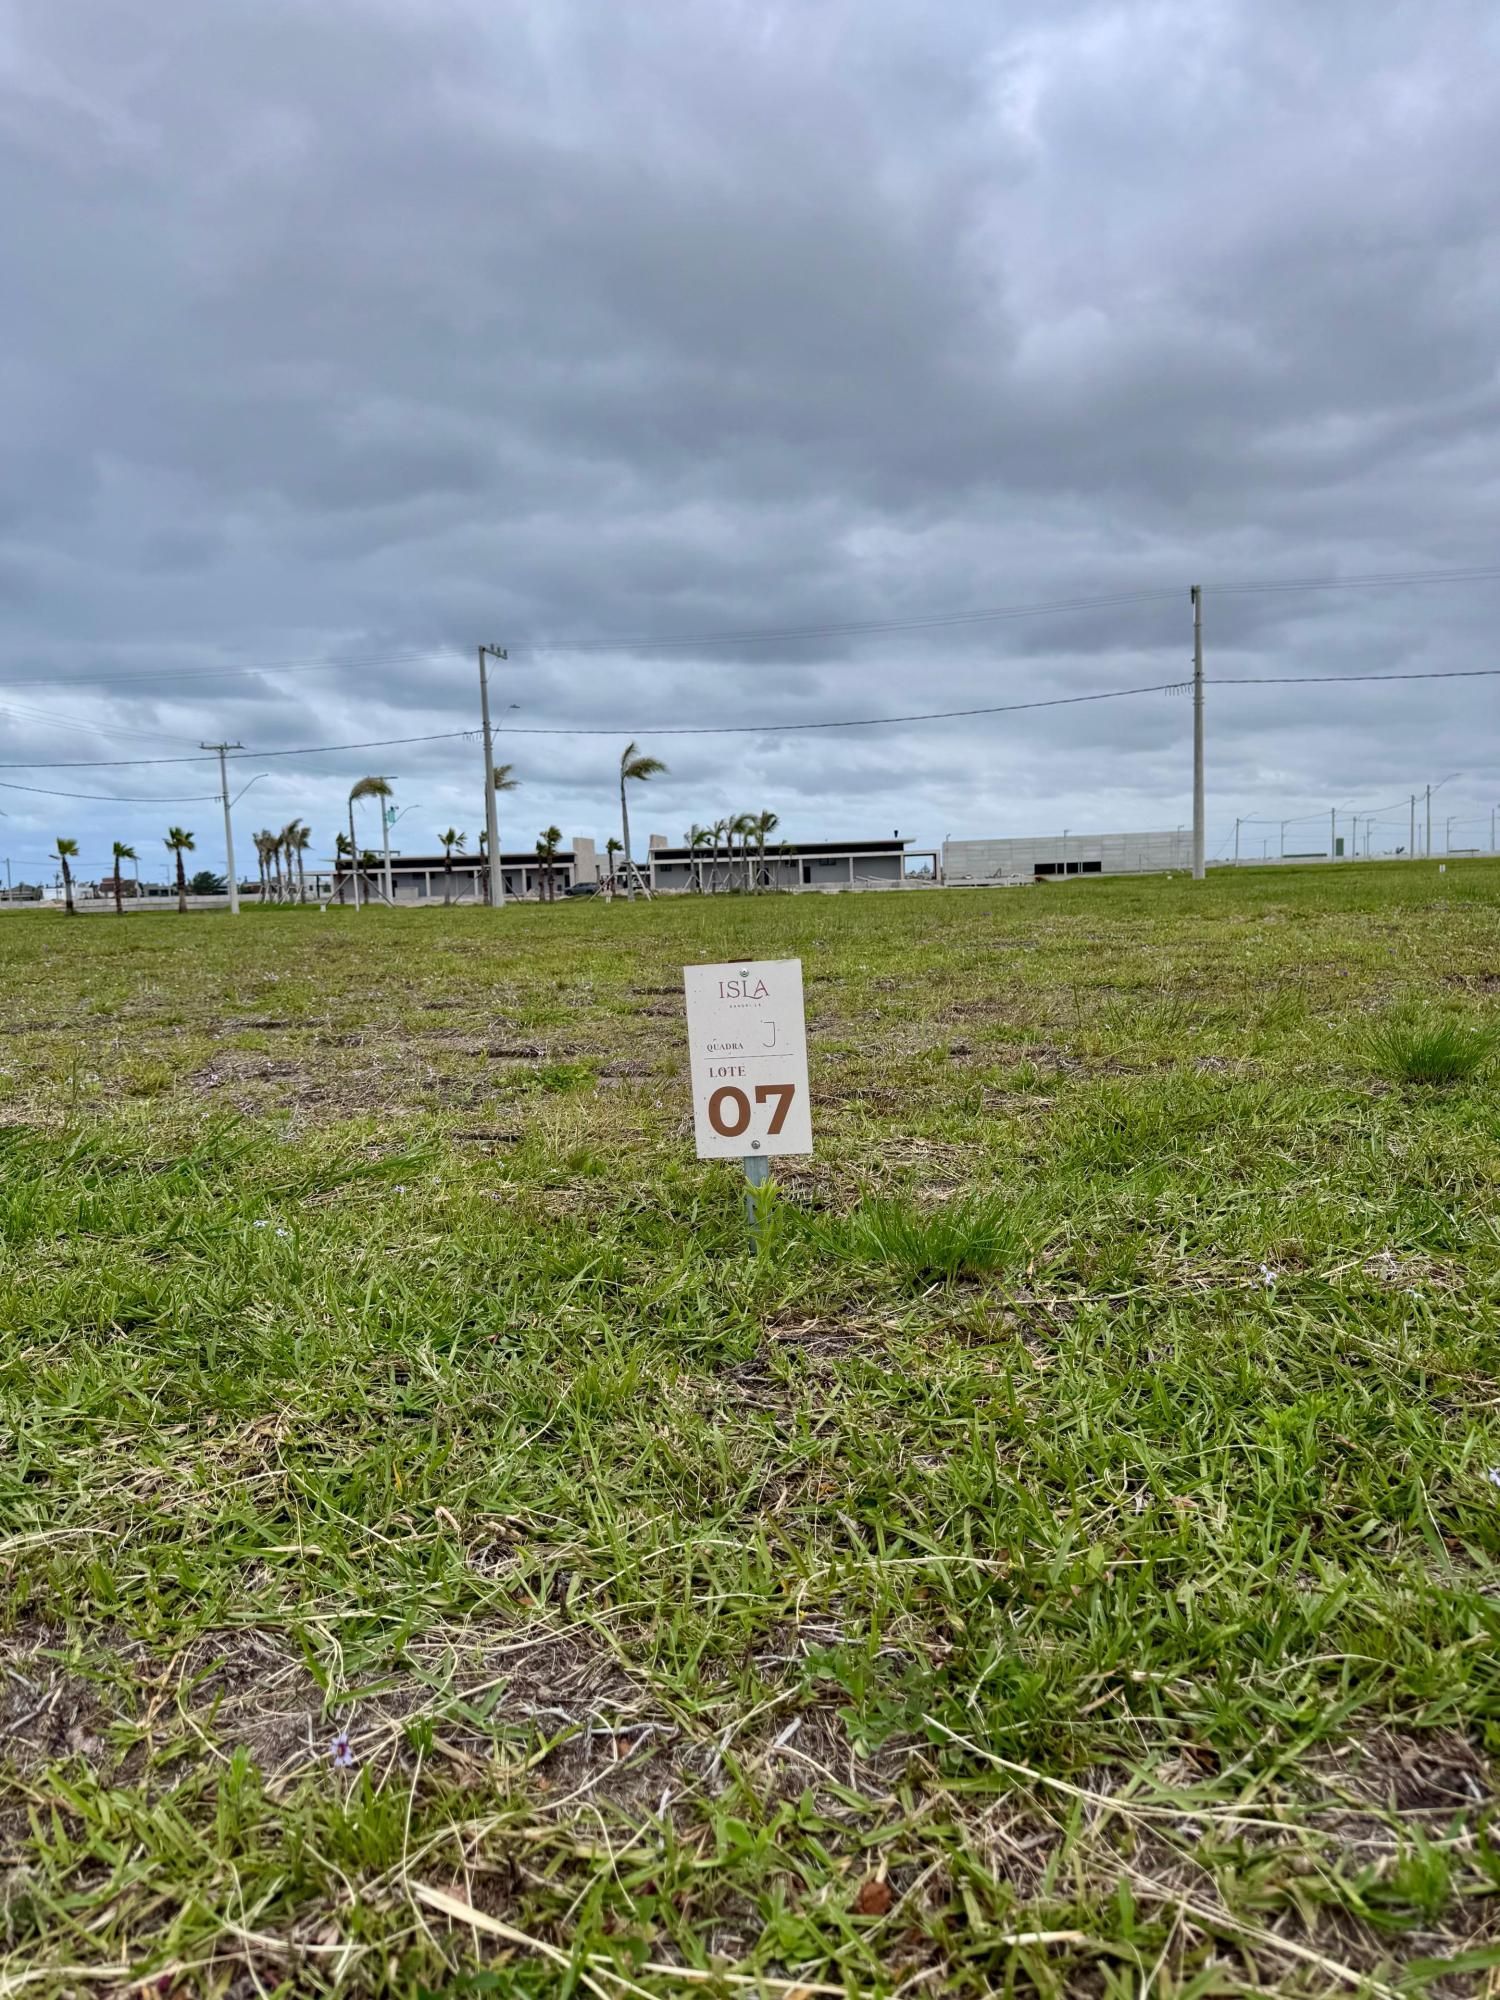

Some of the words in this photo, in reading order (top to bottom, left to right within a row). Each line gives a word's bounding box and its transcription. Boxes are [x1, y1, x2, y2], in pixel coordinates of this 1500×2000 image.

[718, 979, 770, 999] ISLA
[706, 1043, 744, 1053] QUADRA
[762, 1021, 776, 1048] J
[709, 1065, 746, 1078] LOTE
[708, 1083, 796, 1138] 07
